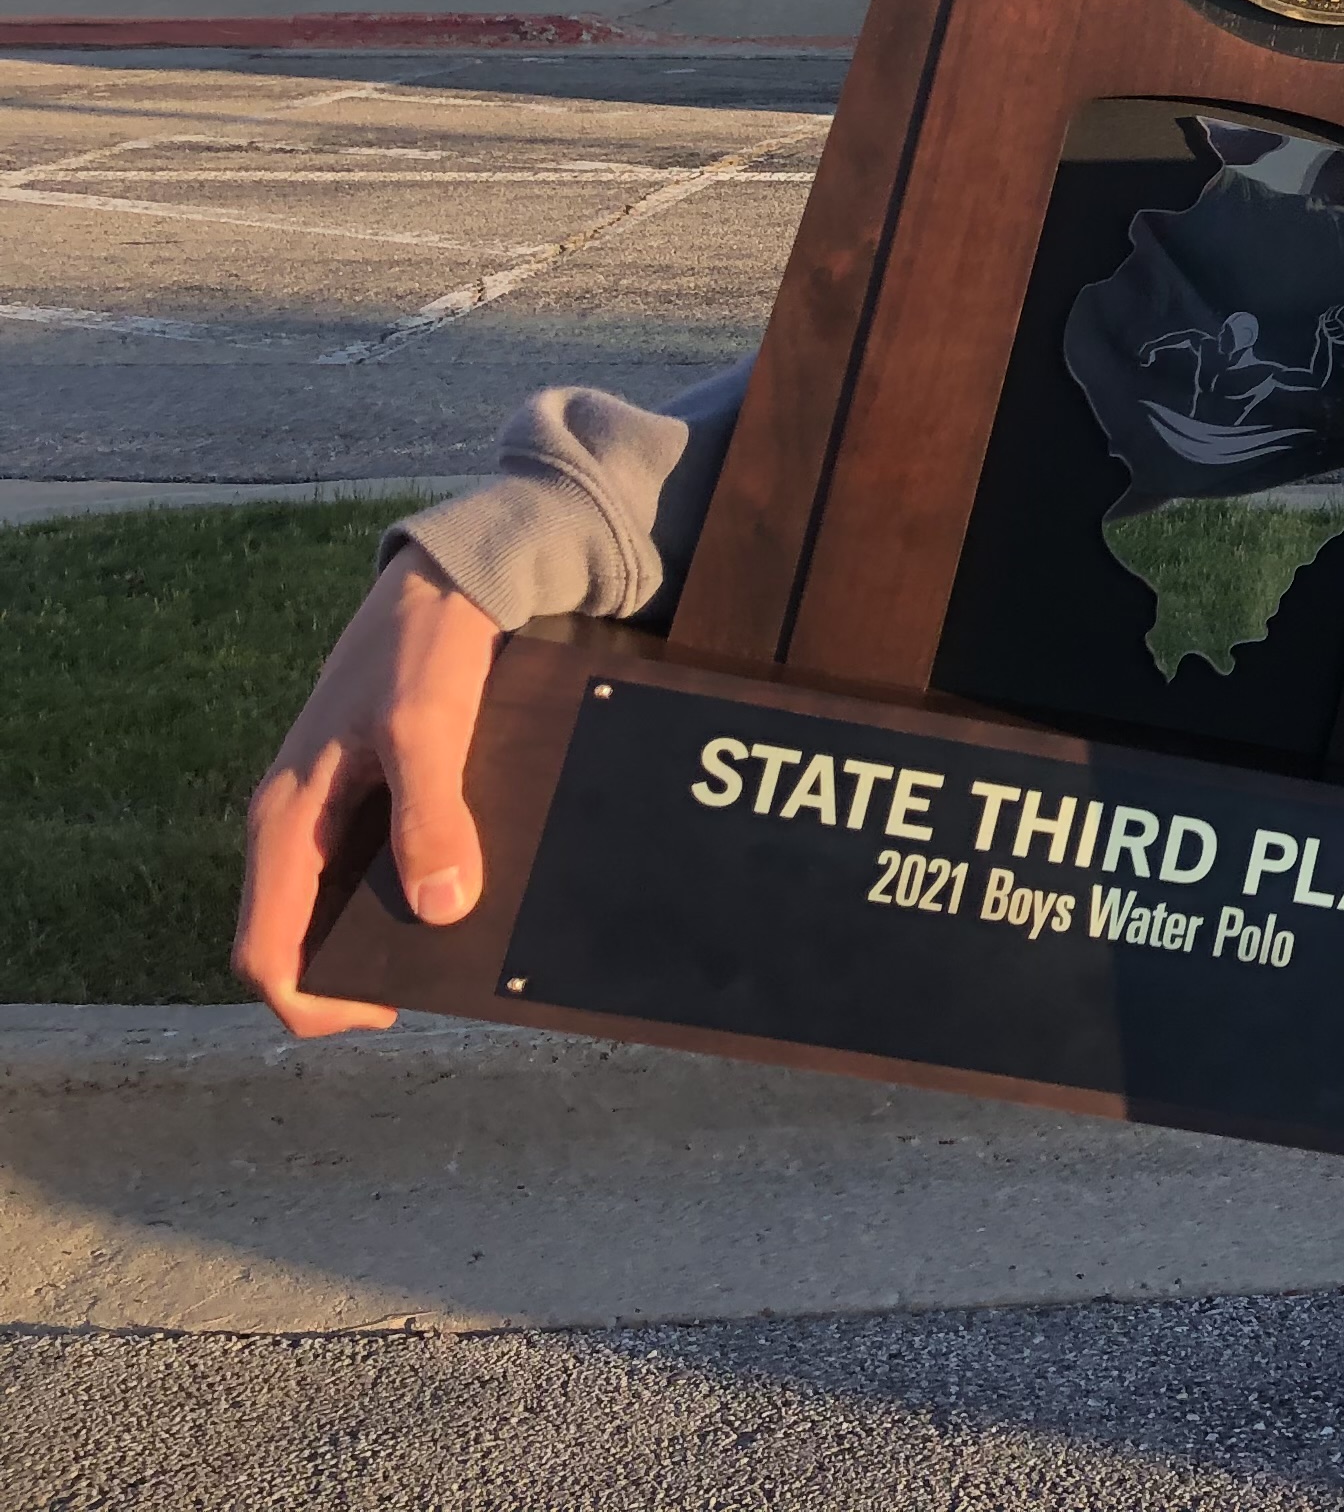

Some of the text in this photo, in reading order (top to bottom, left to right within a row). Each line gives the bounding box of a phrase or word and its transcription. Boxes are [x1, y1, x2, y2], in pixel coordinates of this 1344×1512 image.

[690, 736, 946, 841] STATE
[968, 781, 1219, 886] THIRD
[867, 849, 1296, 969] 2021 Boys Water Polo
